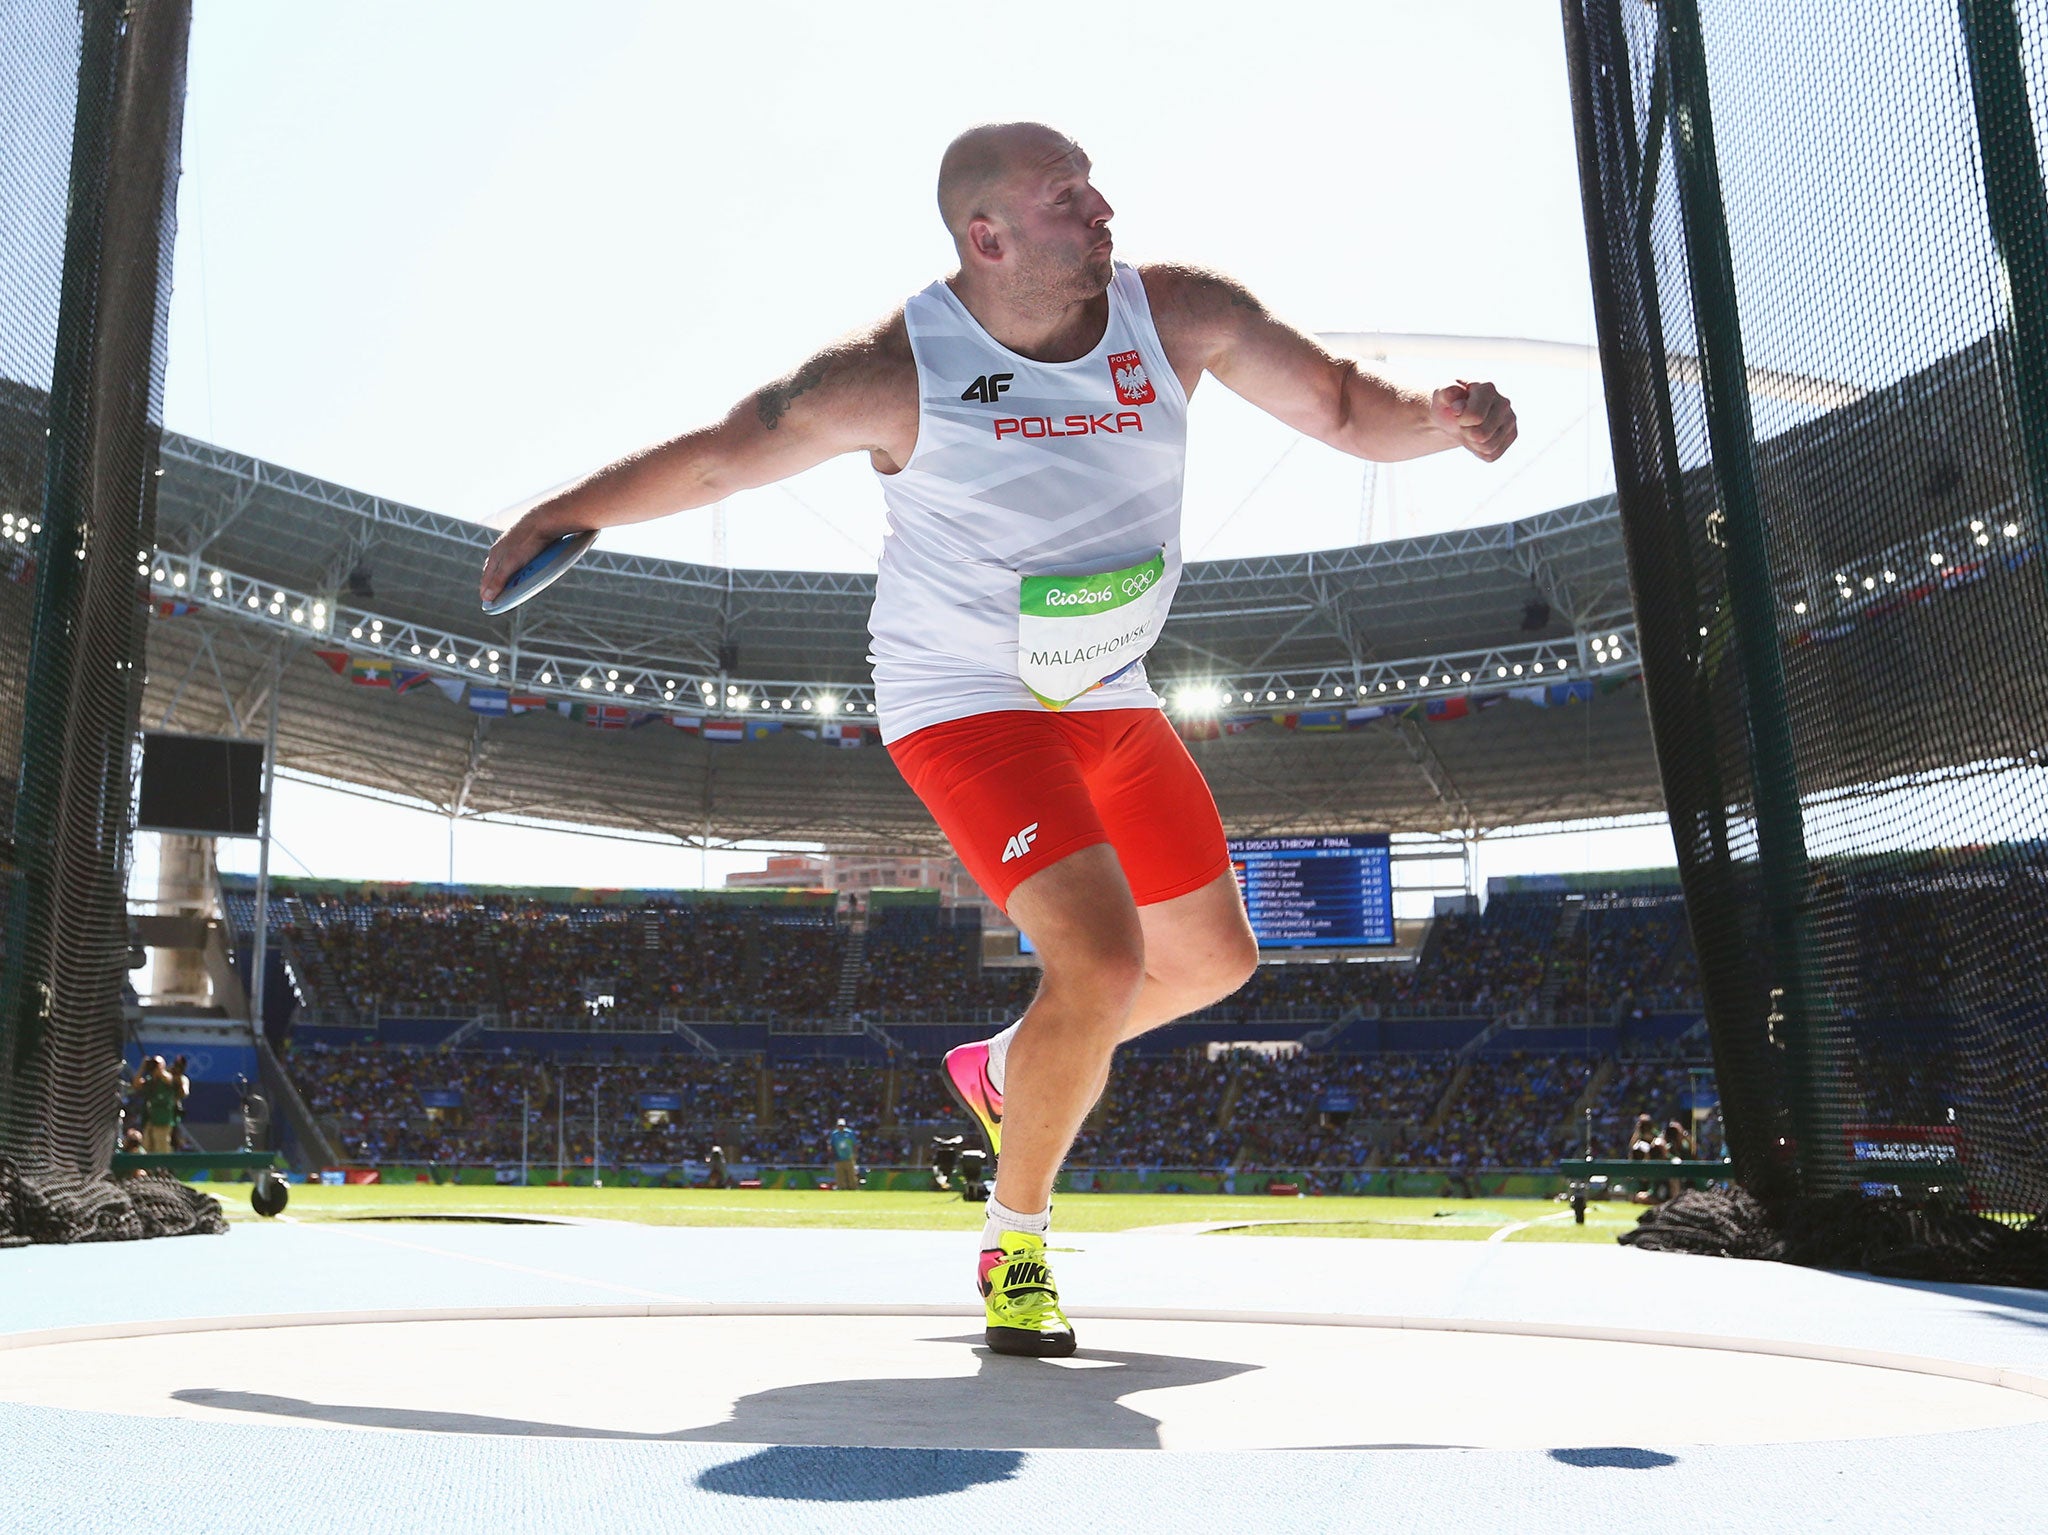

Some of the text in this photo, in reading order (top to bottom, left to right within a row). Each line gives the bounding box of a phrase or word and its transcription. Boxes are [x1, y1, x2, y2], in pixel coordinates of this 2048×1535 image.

[1111, 352, 1138, 364] POLSK
[961, 373, 1015, 403] 4F
[994, 411, 1143, 440] POLSKA
[1002, 822, 1038, 863] 4F
[1228, 840, 1245, 851] EN'S
[1246, 840, 1279, 851] DISCUS
[1281, 839, 1316, 850] THROW
[1323, 837, 1351, 848] FINAL
[1003, 1262, 1053, 1288] NIKE
